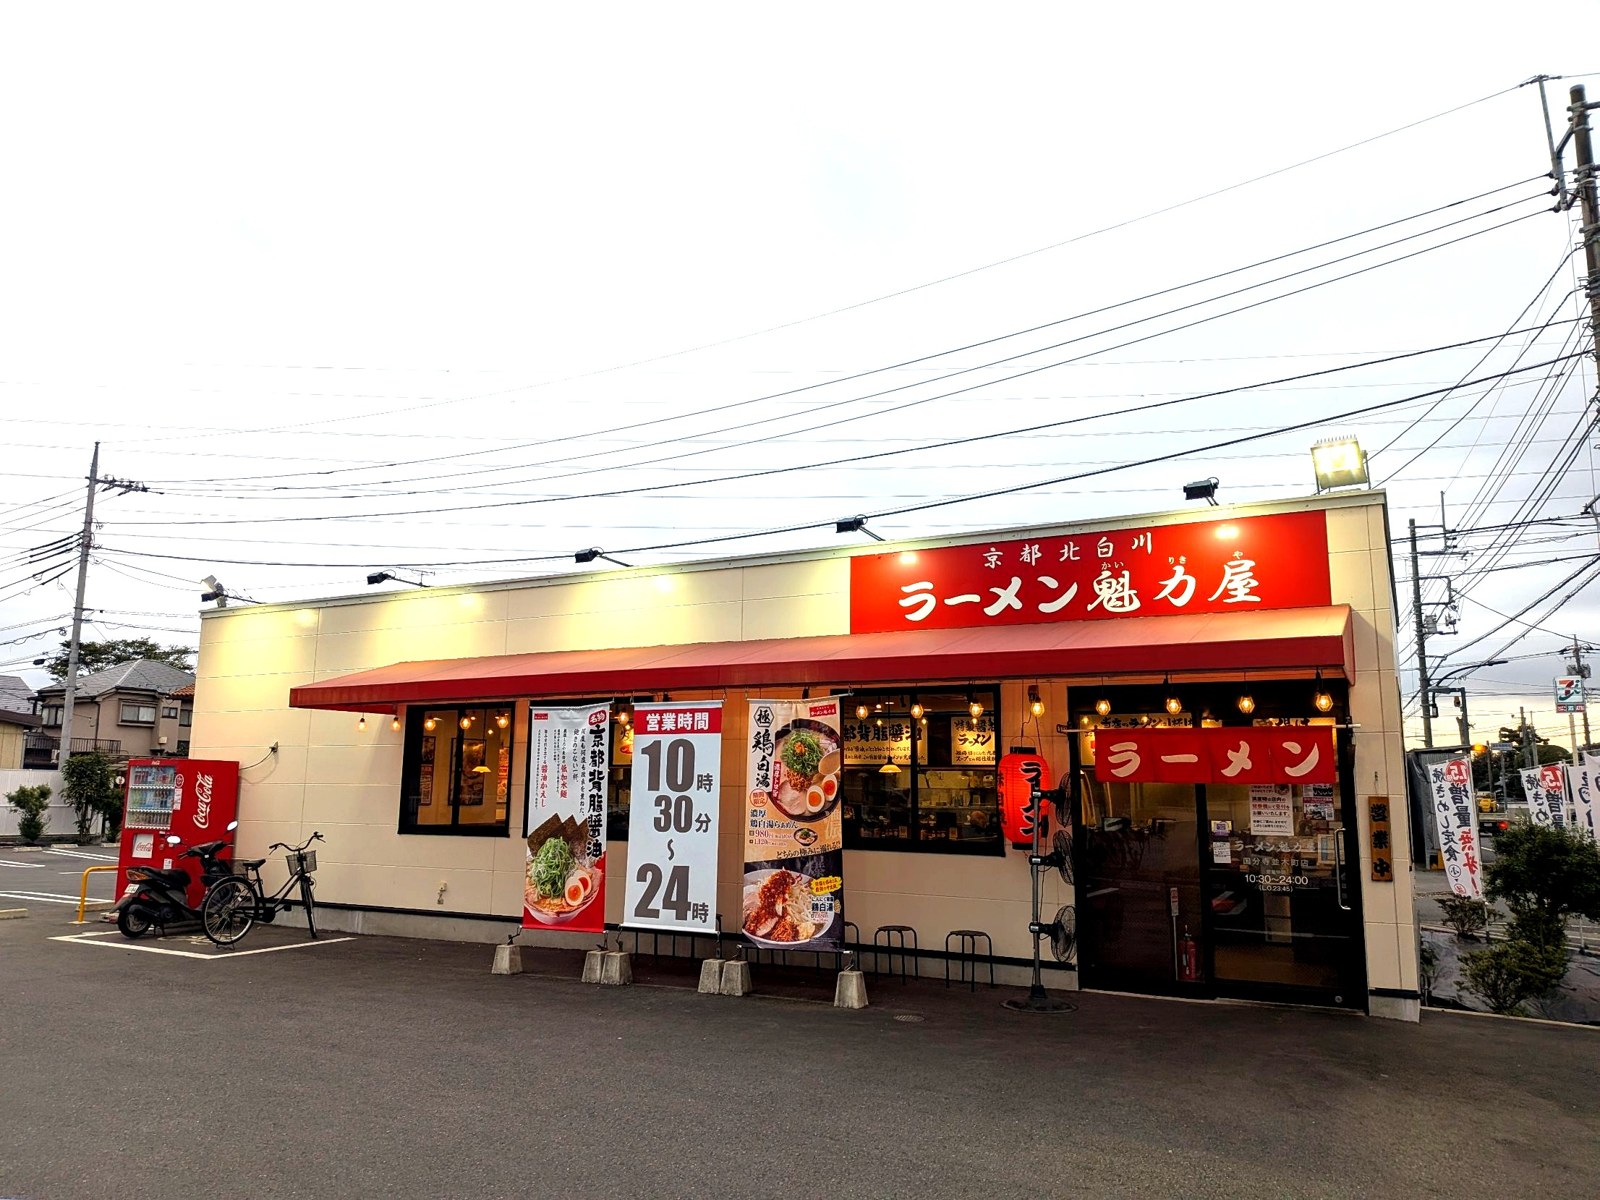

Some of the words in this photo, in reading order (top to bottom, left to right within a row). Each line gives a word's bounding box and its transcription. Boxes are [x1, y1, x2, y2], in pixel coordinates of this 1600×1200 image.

[982, 531, 1152, 570] 京都北白川
[897, 557, 1262, 622] ラーメン魁力屋
[590, 711, 606, 723] 名物
[646, 712, 709, 732] 営業時間
[757, 709, 771, 725] 極
[752, 729, 775, 788] 鶏白湯
[958, 733, 992, 747] ラーメン
[641, 739, 714, 792] 10時
[1108, 741, 1319, 777] ラーメン
[586, 723, 607, 859] 京都背脂醤油
[654, 795, 712, 834] 30分
[750, 809, 767, 818] 濃厚
[1369, 803, 1391, 878] 営業中
[1243, 857, 1309, 867] 国分寺並木町店
[634, 863, 709, 923] 24時
[811, 902, 834, 912] 鶏白湯
